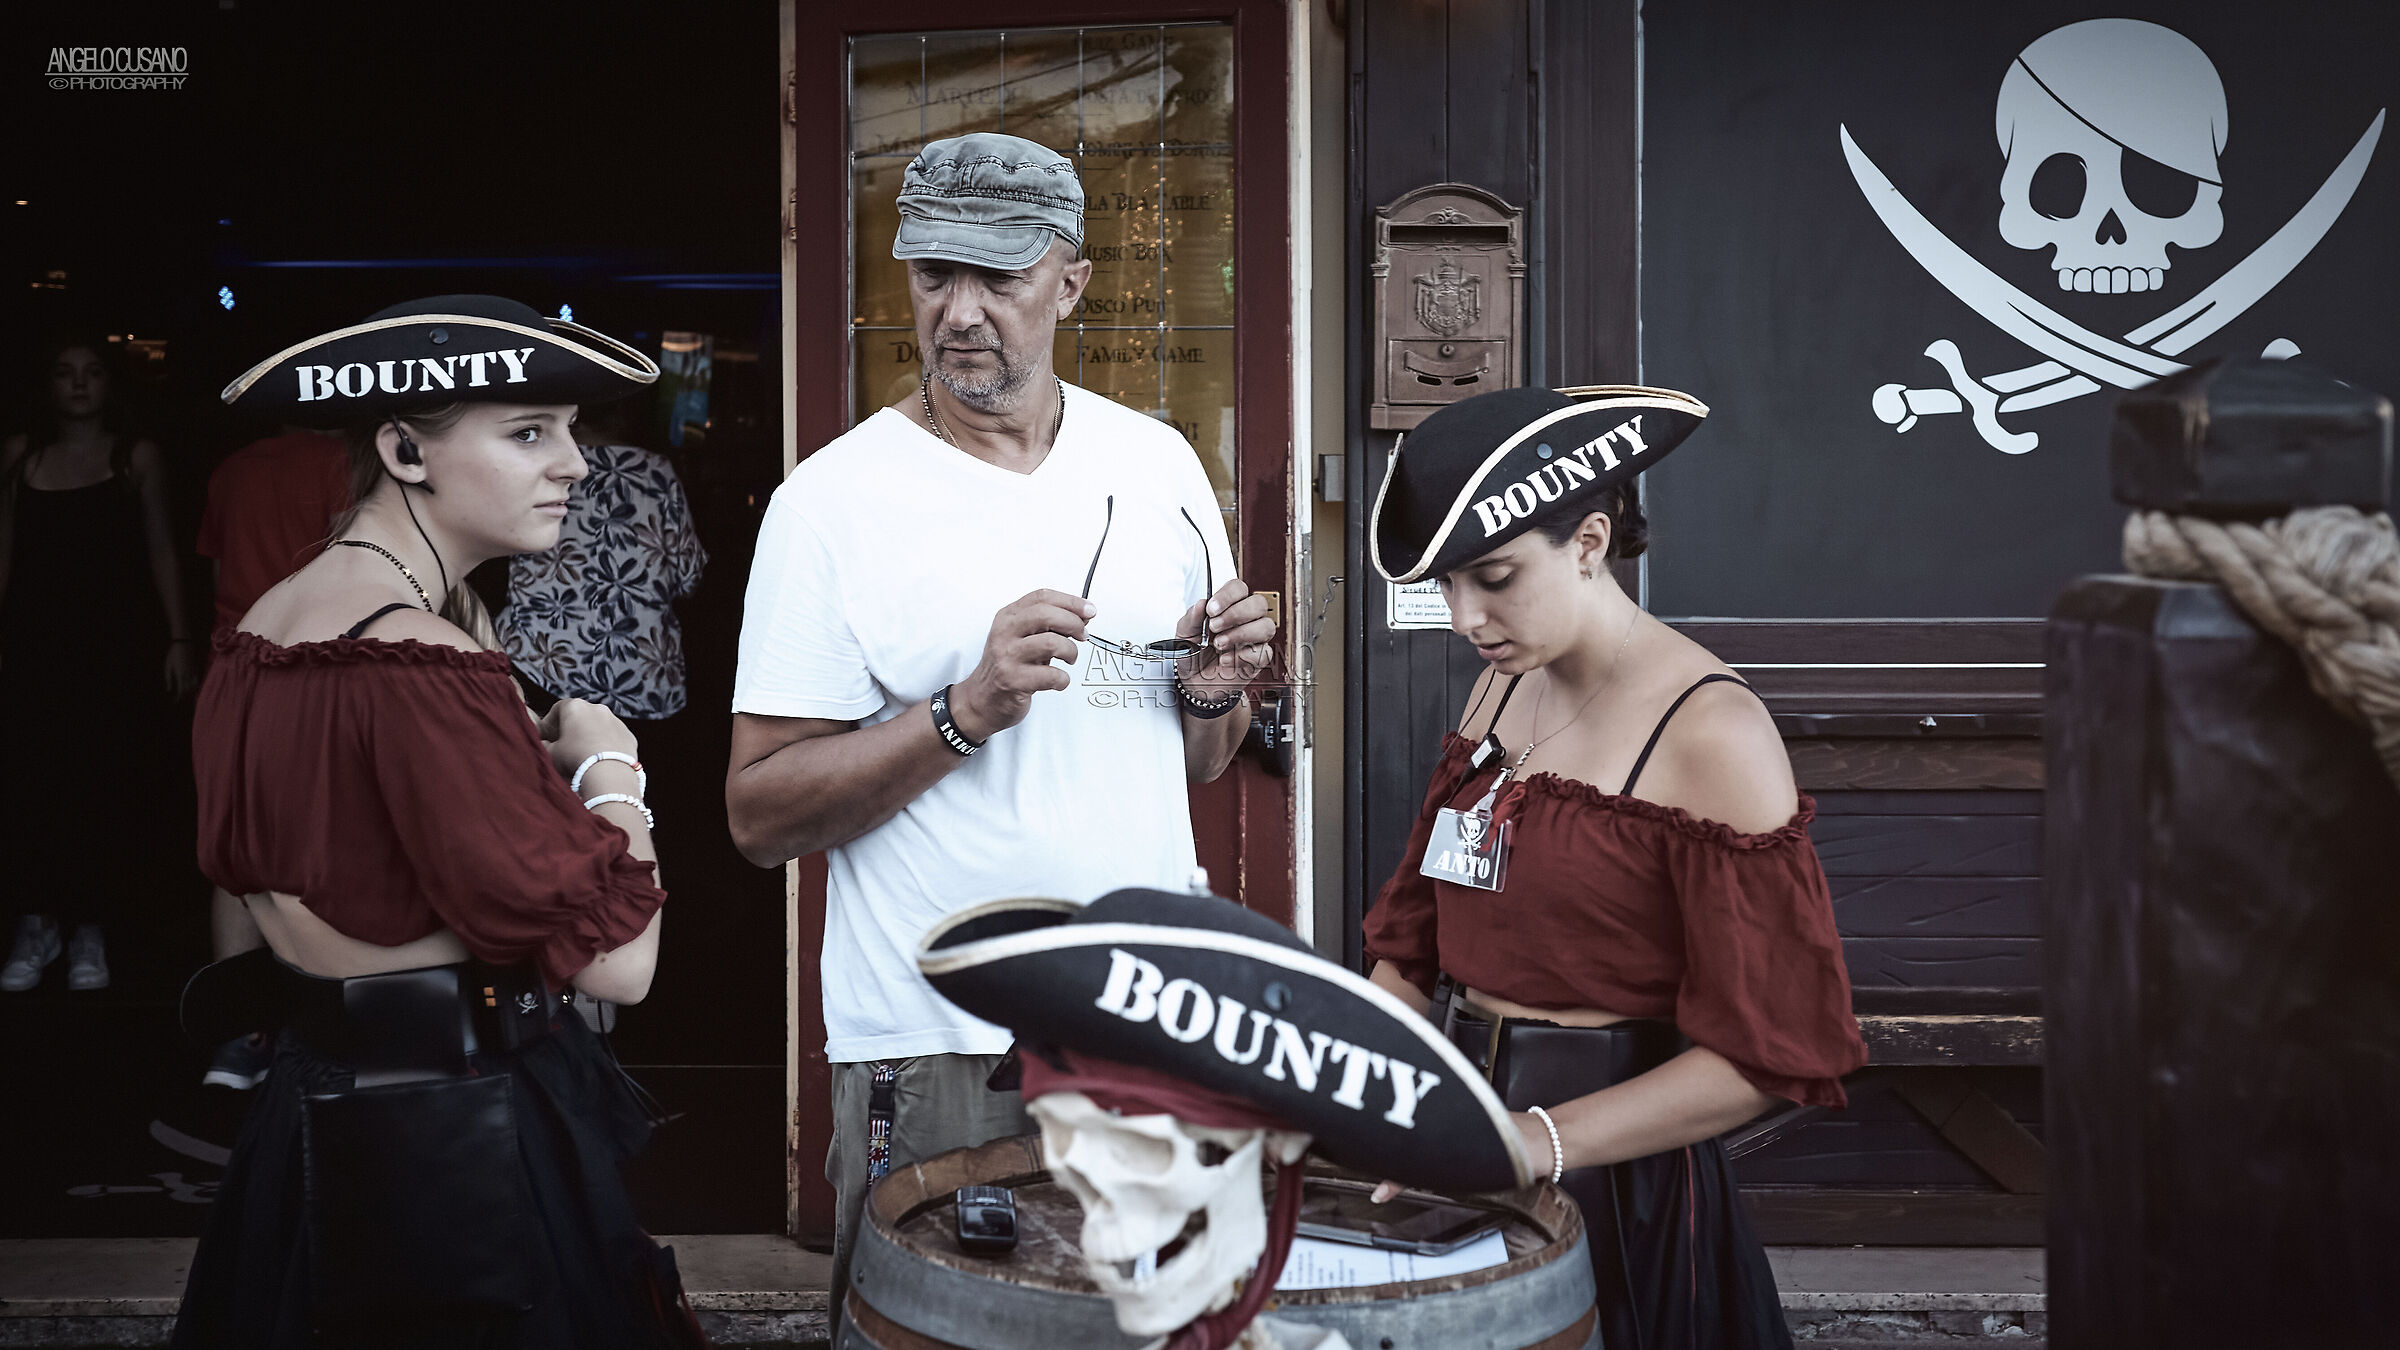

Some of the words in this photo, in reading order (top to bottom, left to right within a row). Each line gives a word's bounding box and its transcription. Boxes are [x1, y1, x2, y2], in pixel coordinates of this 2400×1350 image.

[1086, 196, 1110, 211] LA
[295, 347, 535, 402] BOUNTY
[1074, 344, 1145, 363] FAMILY
[1151, 344, 1206, 363] GAME
[1472, 414, 1649, 538] BOUNTY
[1432, 850, 1491, 880] ANTO
[1094, 948, 1442, 1129] BOUNTY
